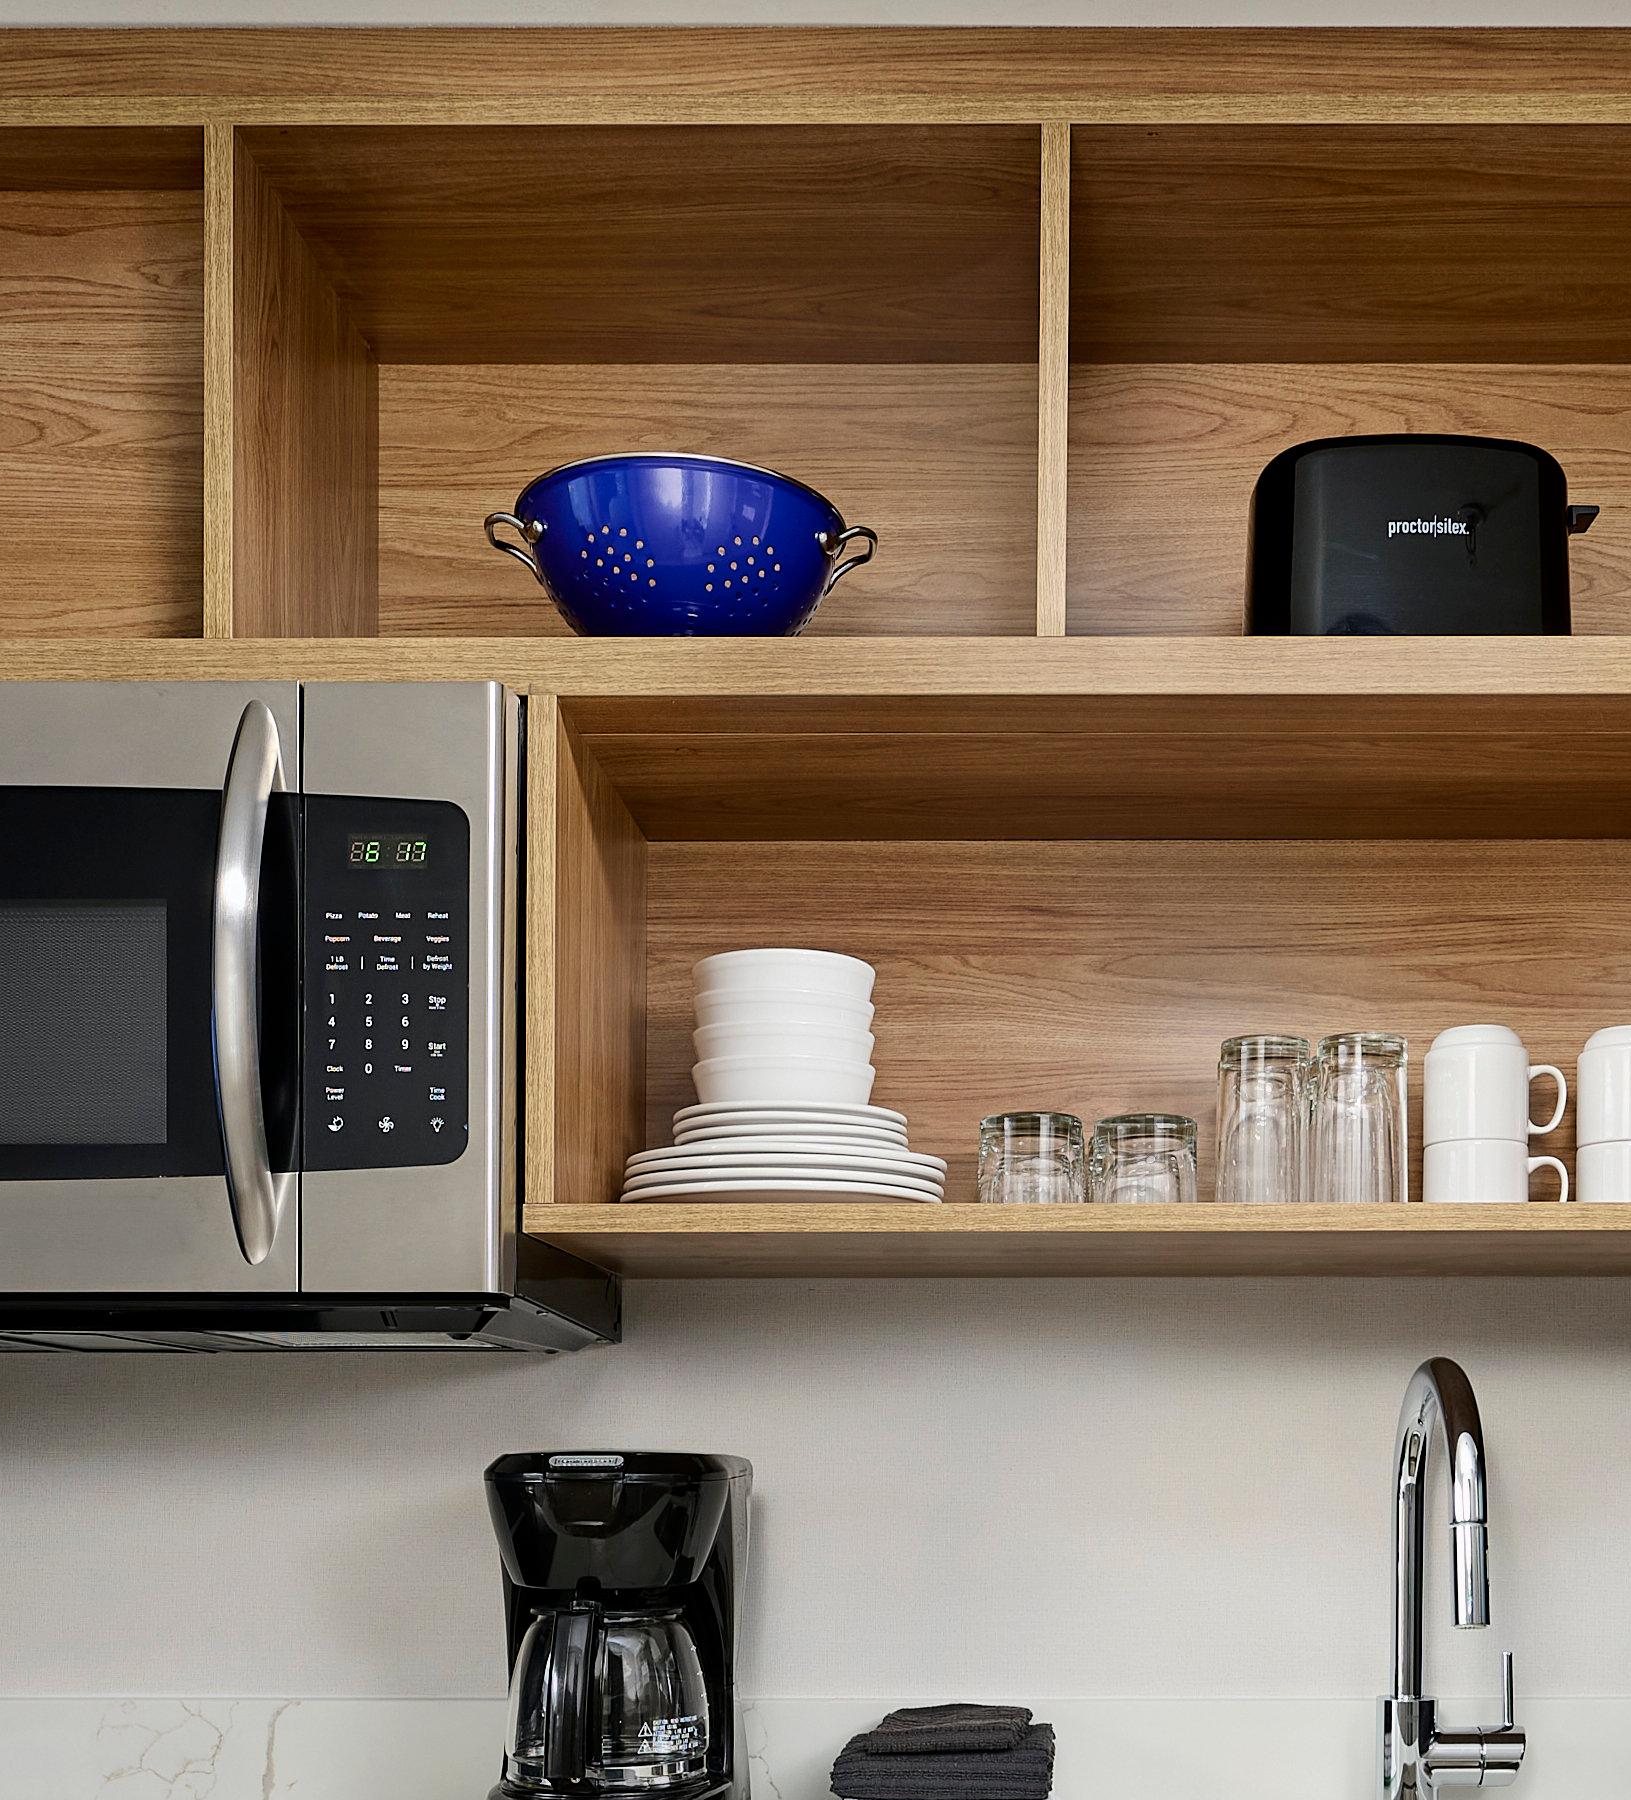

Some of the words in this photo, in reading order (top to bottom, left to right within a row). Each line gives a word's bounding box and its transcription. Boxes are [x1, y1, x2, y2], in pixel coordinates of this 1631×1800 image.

[325, 935, 350, 943] Popcorn
[373, 935, 401, 943] Beverage
[426, 935, 449, 943] Veggies
[329, 993, 335, 1005] 1
[365, 993, 373, 1005] 2
[401, 993, 409, 1005] 3
[428, 995, 447, 1005] Stop
[328, 1016, 336, 1027] 4
[365, 1016, 373, 1027] 5
[401, 1016, 409, 1027] 6
[328, 1039, 336, 1050] 7
[365, 1039, 373, 1050] 8
[401, 1039, 409, 1050] 9
[428, 1042, 447, 1050] Start
[364, 1063, 373, 1074] 0
[394, 1065, 412, 1073] Timer
